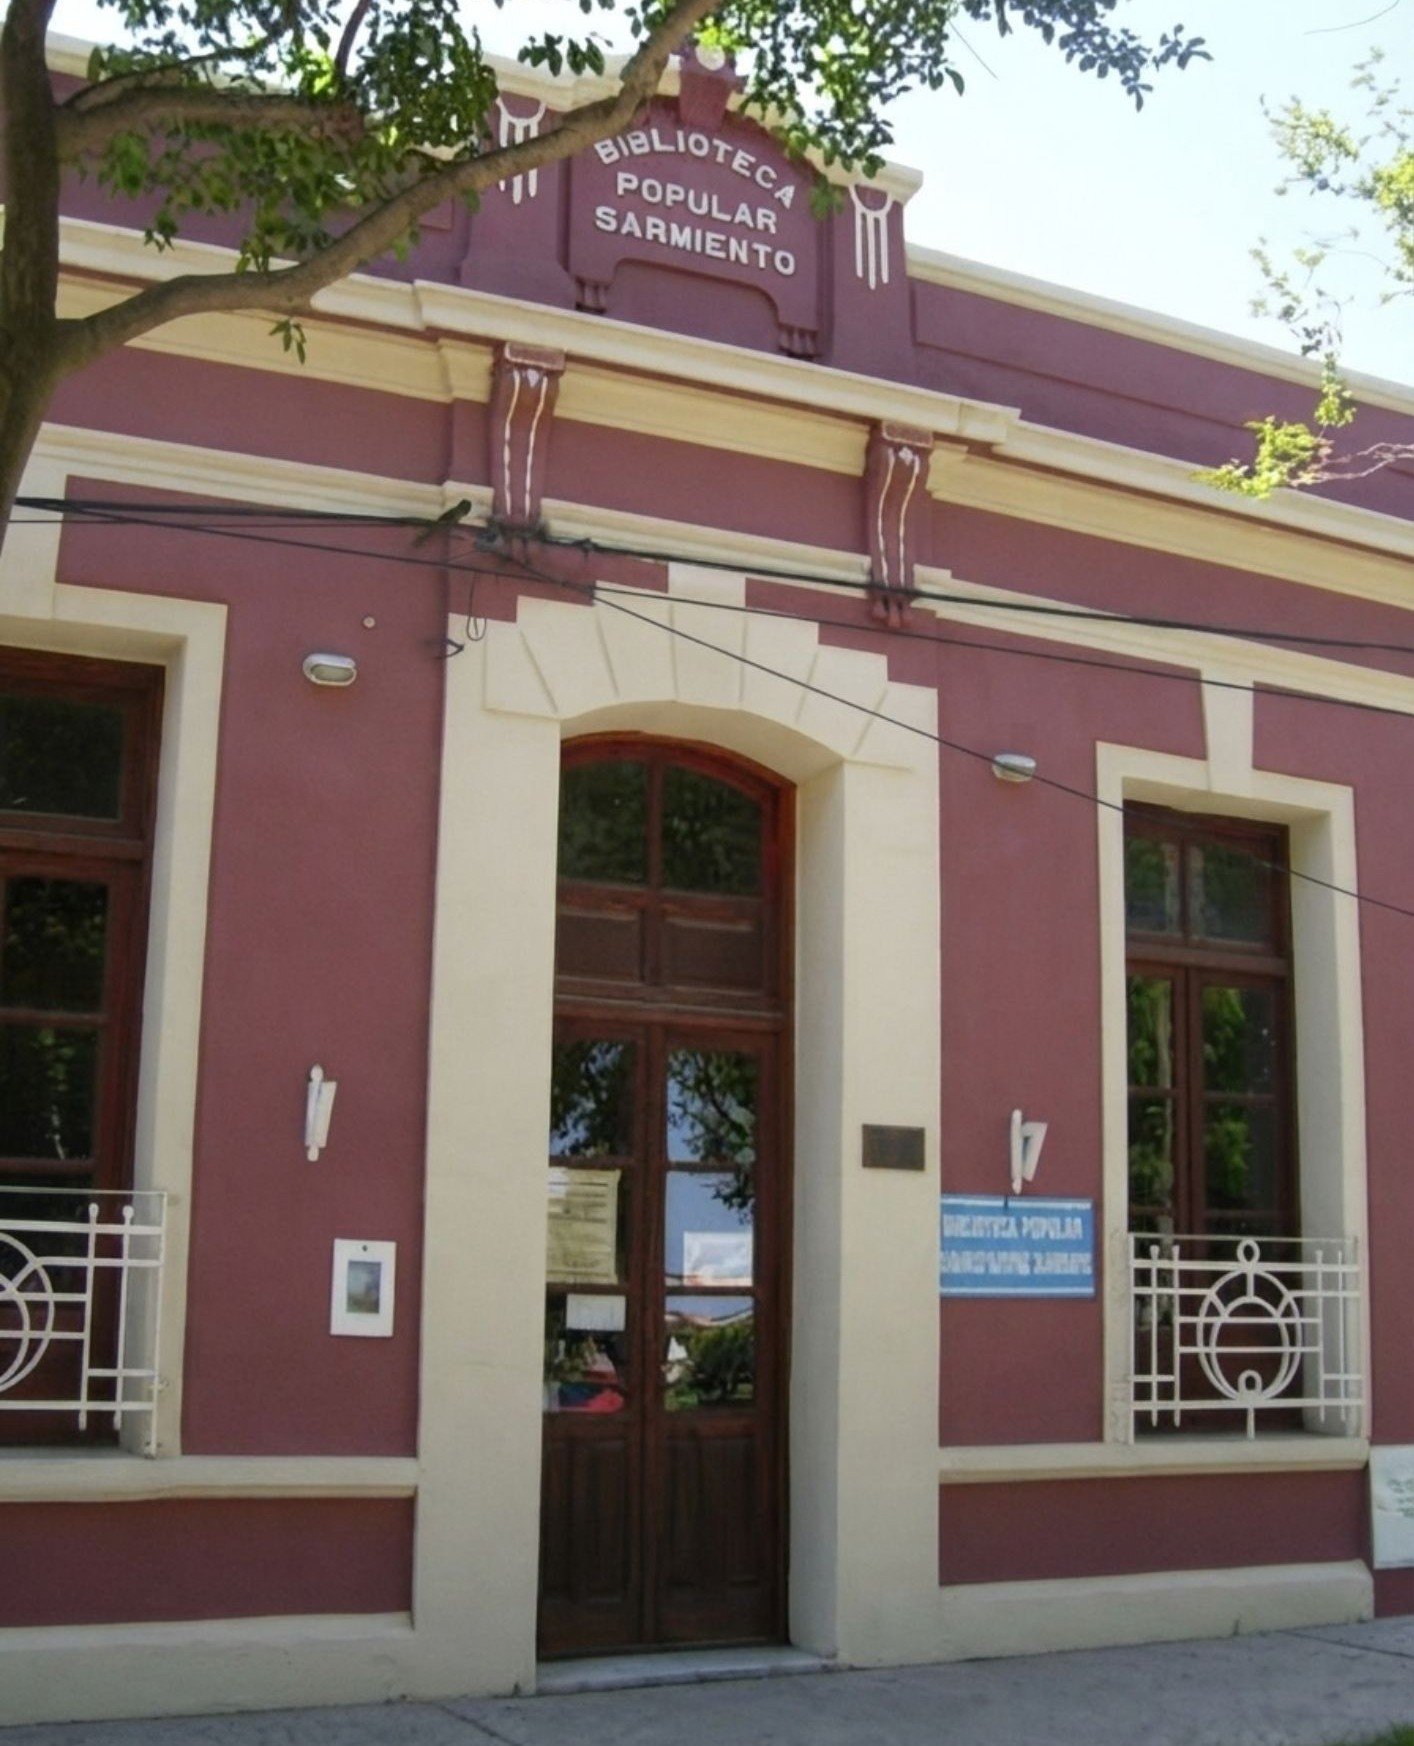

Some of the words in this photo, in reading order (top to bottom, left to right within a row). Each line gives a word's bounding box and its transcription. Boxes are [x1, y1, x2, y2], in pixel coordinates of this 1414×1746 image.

[594, 128, 796, 209] BIBLIOTECA
[616, 171, 778, 234] POPULAR
[595, 206, 796, 275] SARMIENTO
